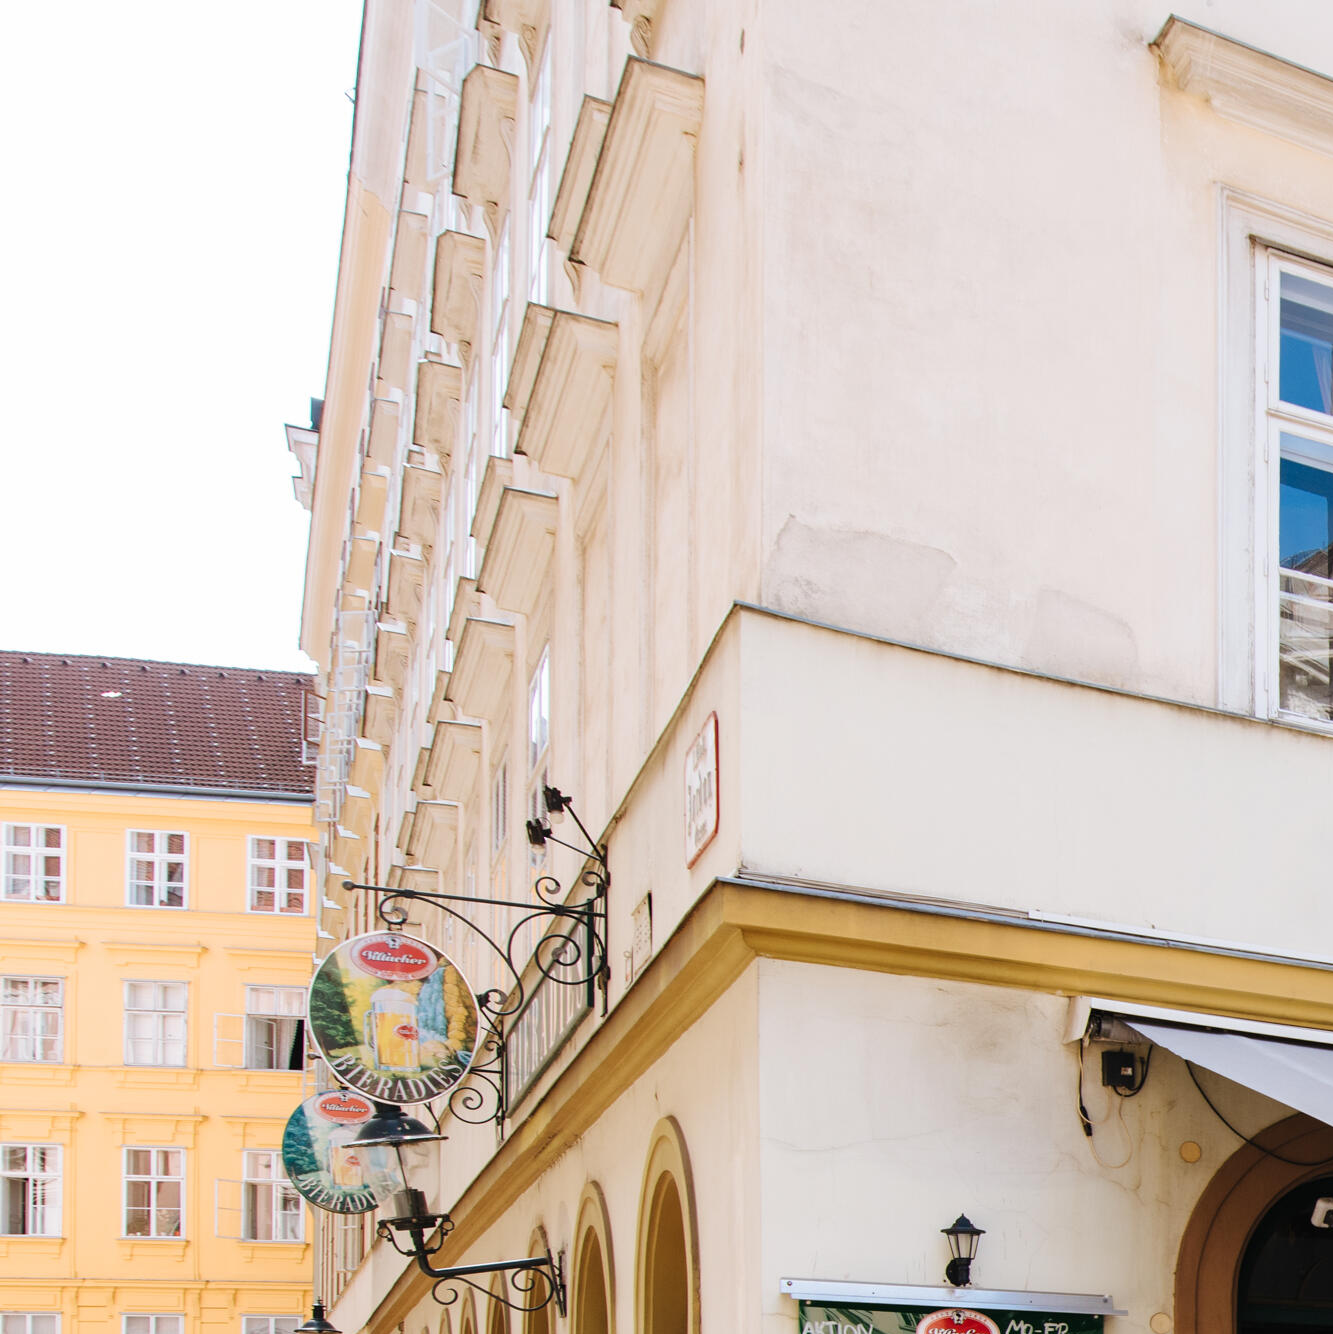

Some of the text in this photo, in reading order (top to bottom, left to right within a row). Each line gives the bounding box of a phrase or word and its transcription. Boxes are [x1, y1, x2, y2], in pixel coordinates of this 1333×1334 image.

[361, 949, 427, 966] Villacher
[331, 1054, 464, 1101] BIERADIES
[299, 1176, 379, 1212] BIERADI
